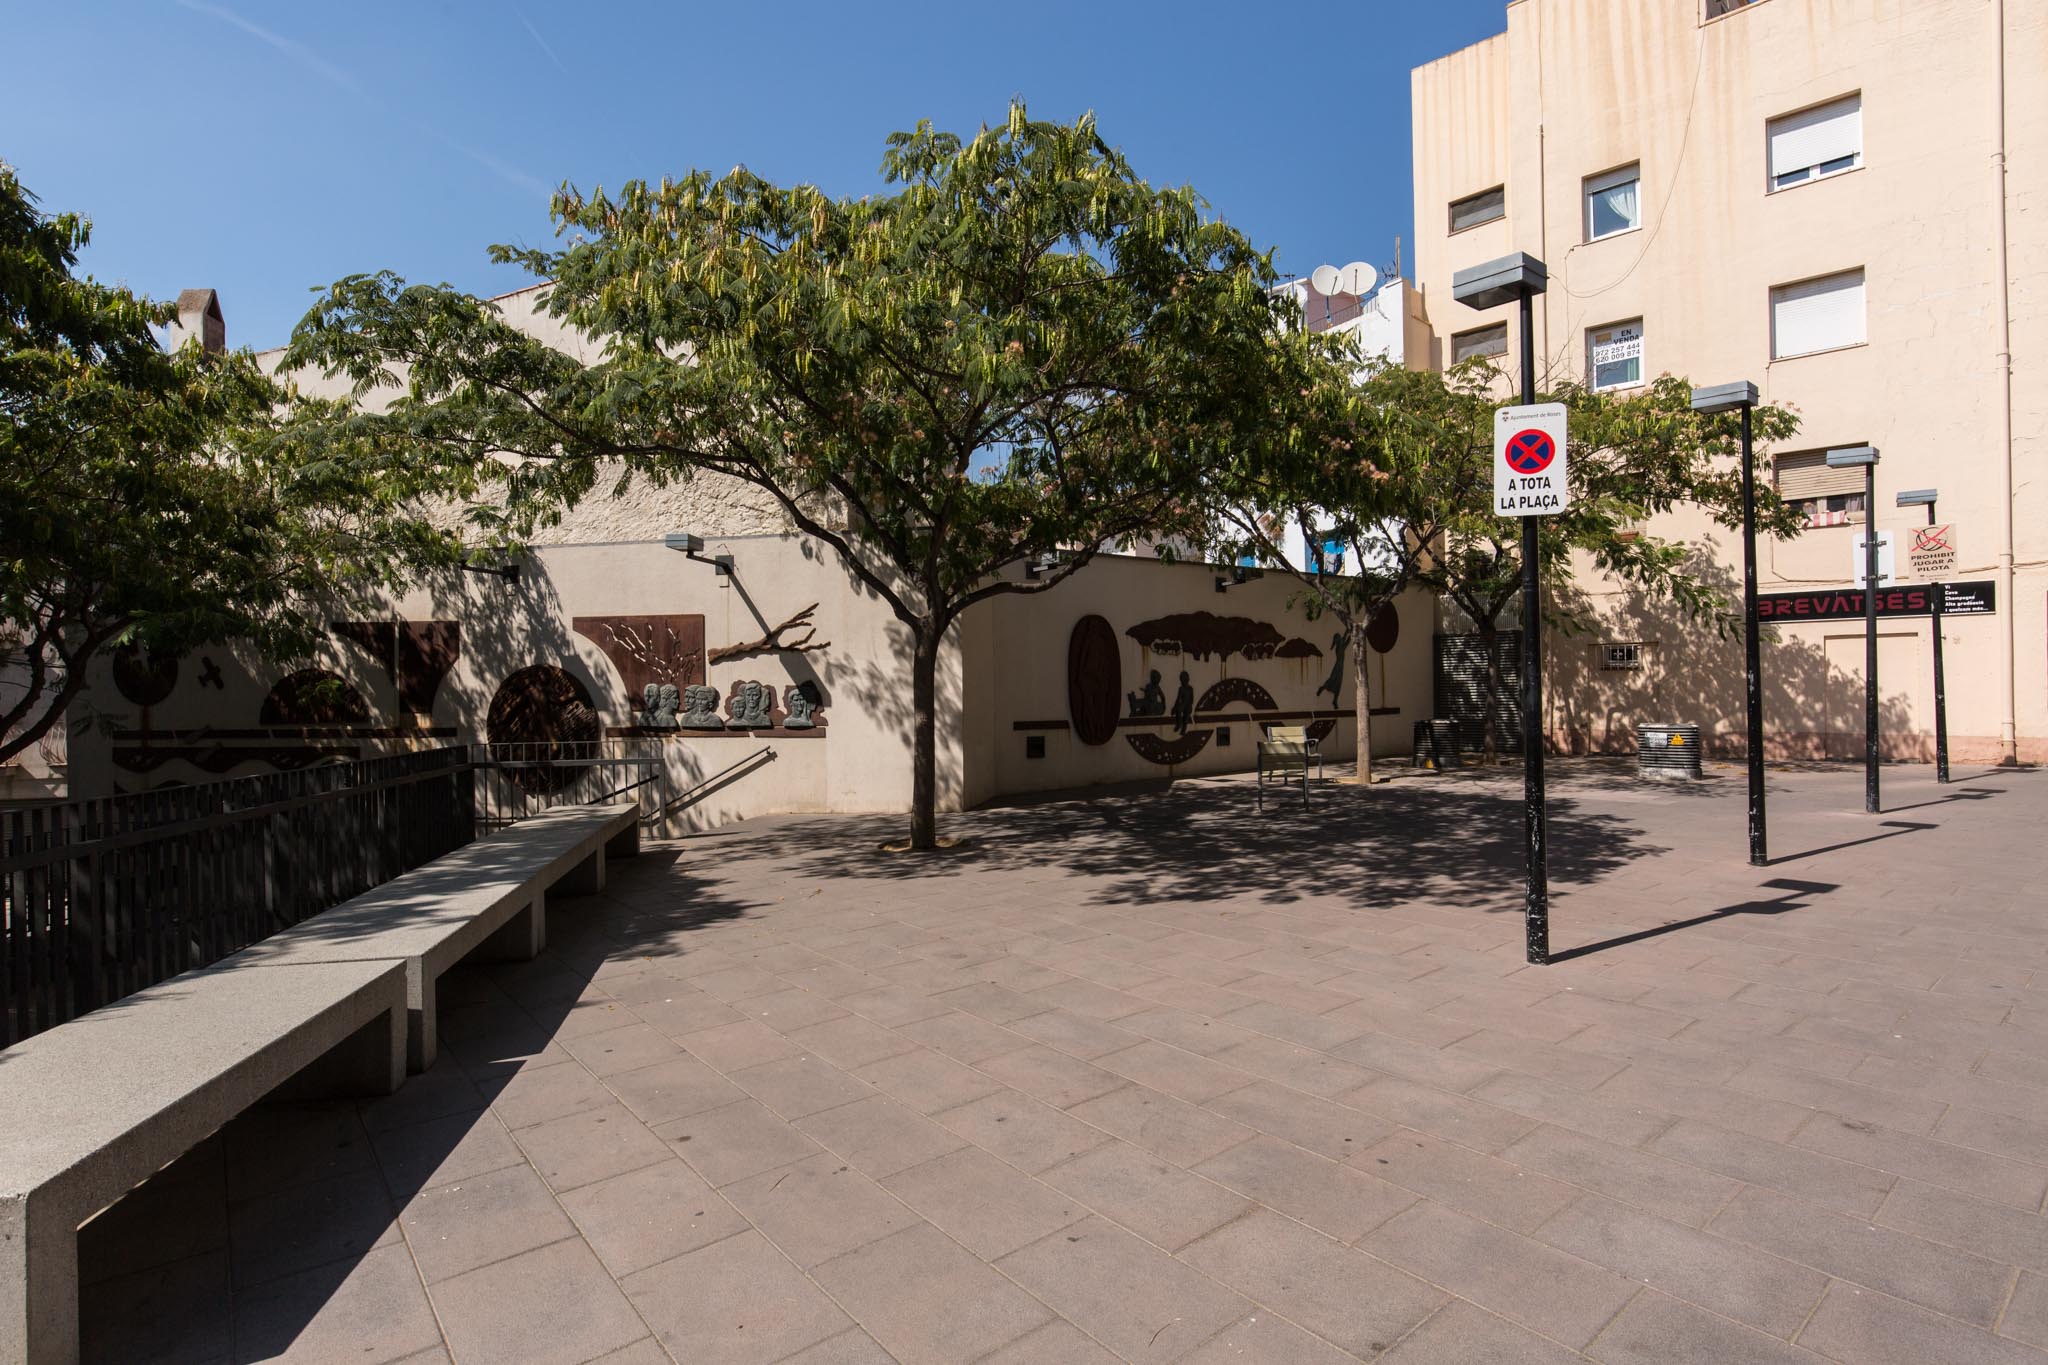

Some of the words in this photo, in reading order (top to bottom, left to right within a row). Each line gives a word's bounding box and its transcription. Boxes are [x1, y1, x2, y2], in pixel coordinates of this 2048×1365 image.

[1621, 328, 1632, 337] EN
[1613, 334, 1640, 345] VENDA
[1595, 349, 1609, 357] 972
[1611, 346, 1625, 354] 257
[1626, 342, 1640, 350] 444
[1626, 349, 1640, 357] 874
[1508, 479, 1516, 491] A
[1520, 476, 1551, 490] TOTA
[1501, 497, 1516, 509] LA
[1519, 494, 1559, 510] PLAÇA
[1911, 552, 1956, 561] PROHIBIT
[1913, 559, 1944, 567] JUGAR
